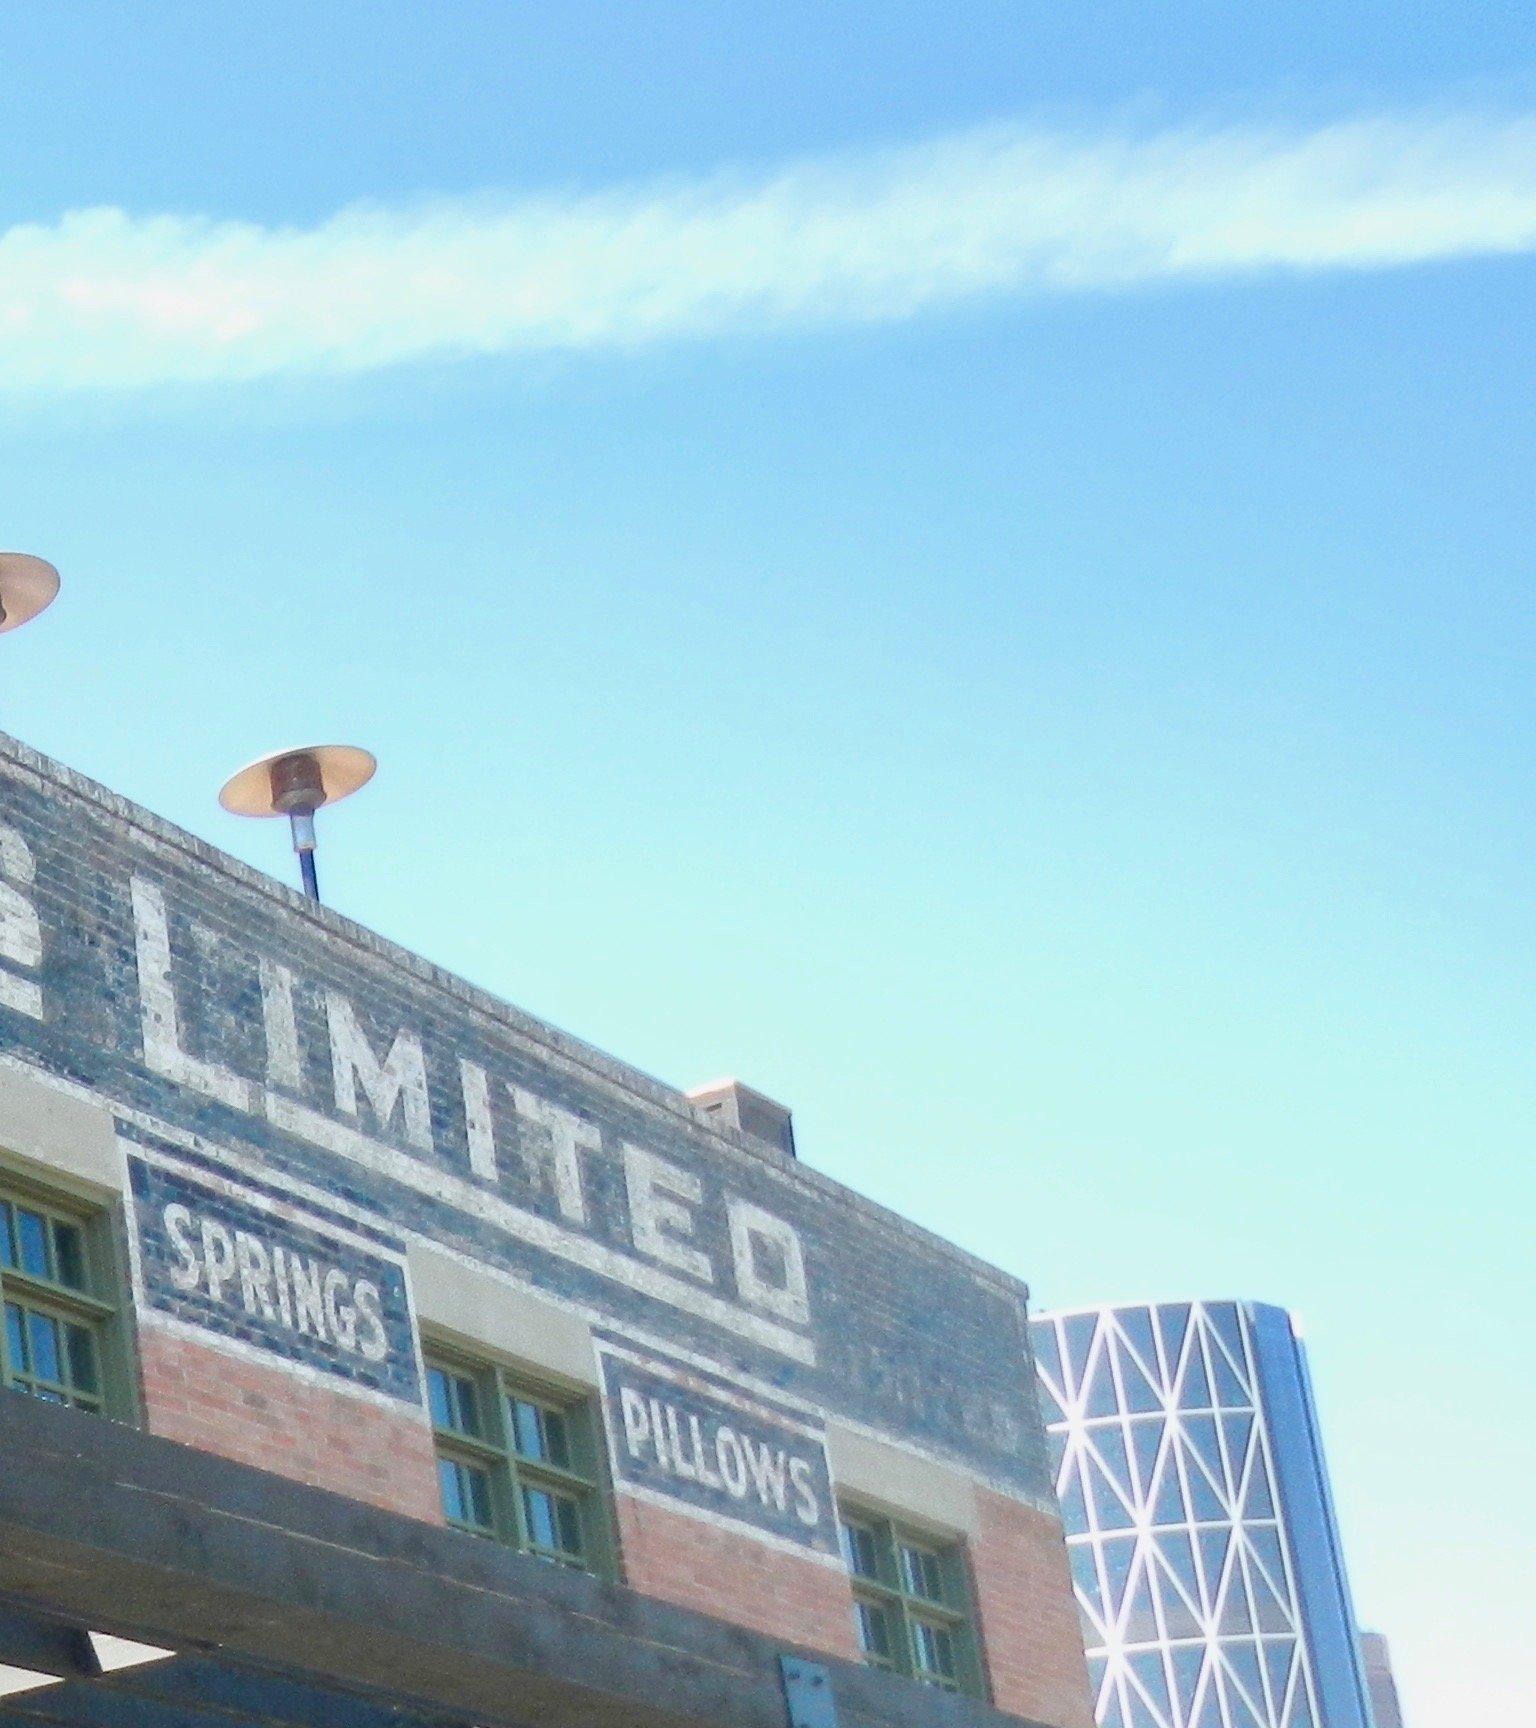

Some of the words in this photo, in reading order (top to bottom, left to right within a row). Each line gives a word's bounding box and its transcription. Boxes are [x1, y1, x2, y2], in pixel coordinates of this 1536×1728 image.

[130, 876, 810, 1326] LIMITED
[163, 1203, 388, 1364] SPRINGS
[620, 1385, 819, 1526] PILLOWS
